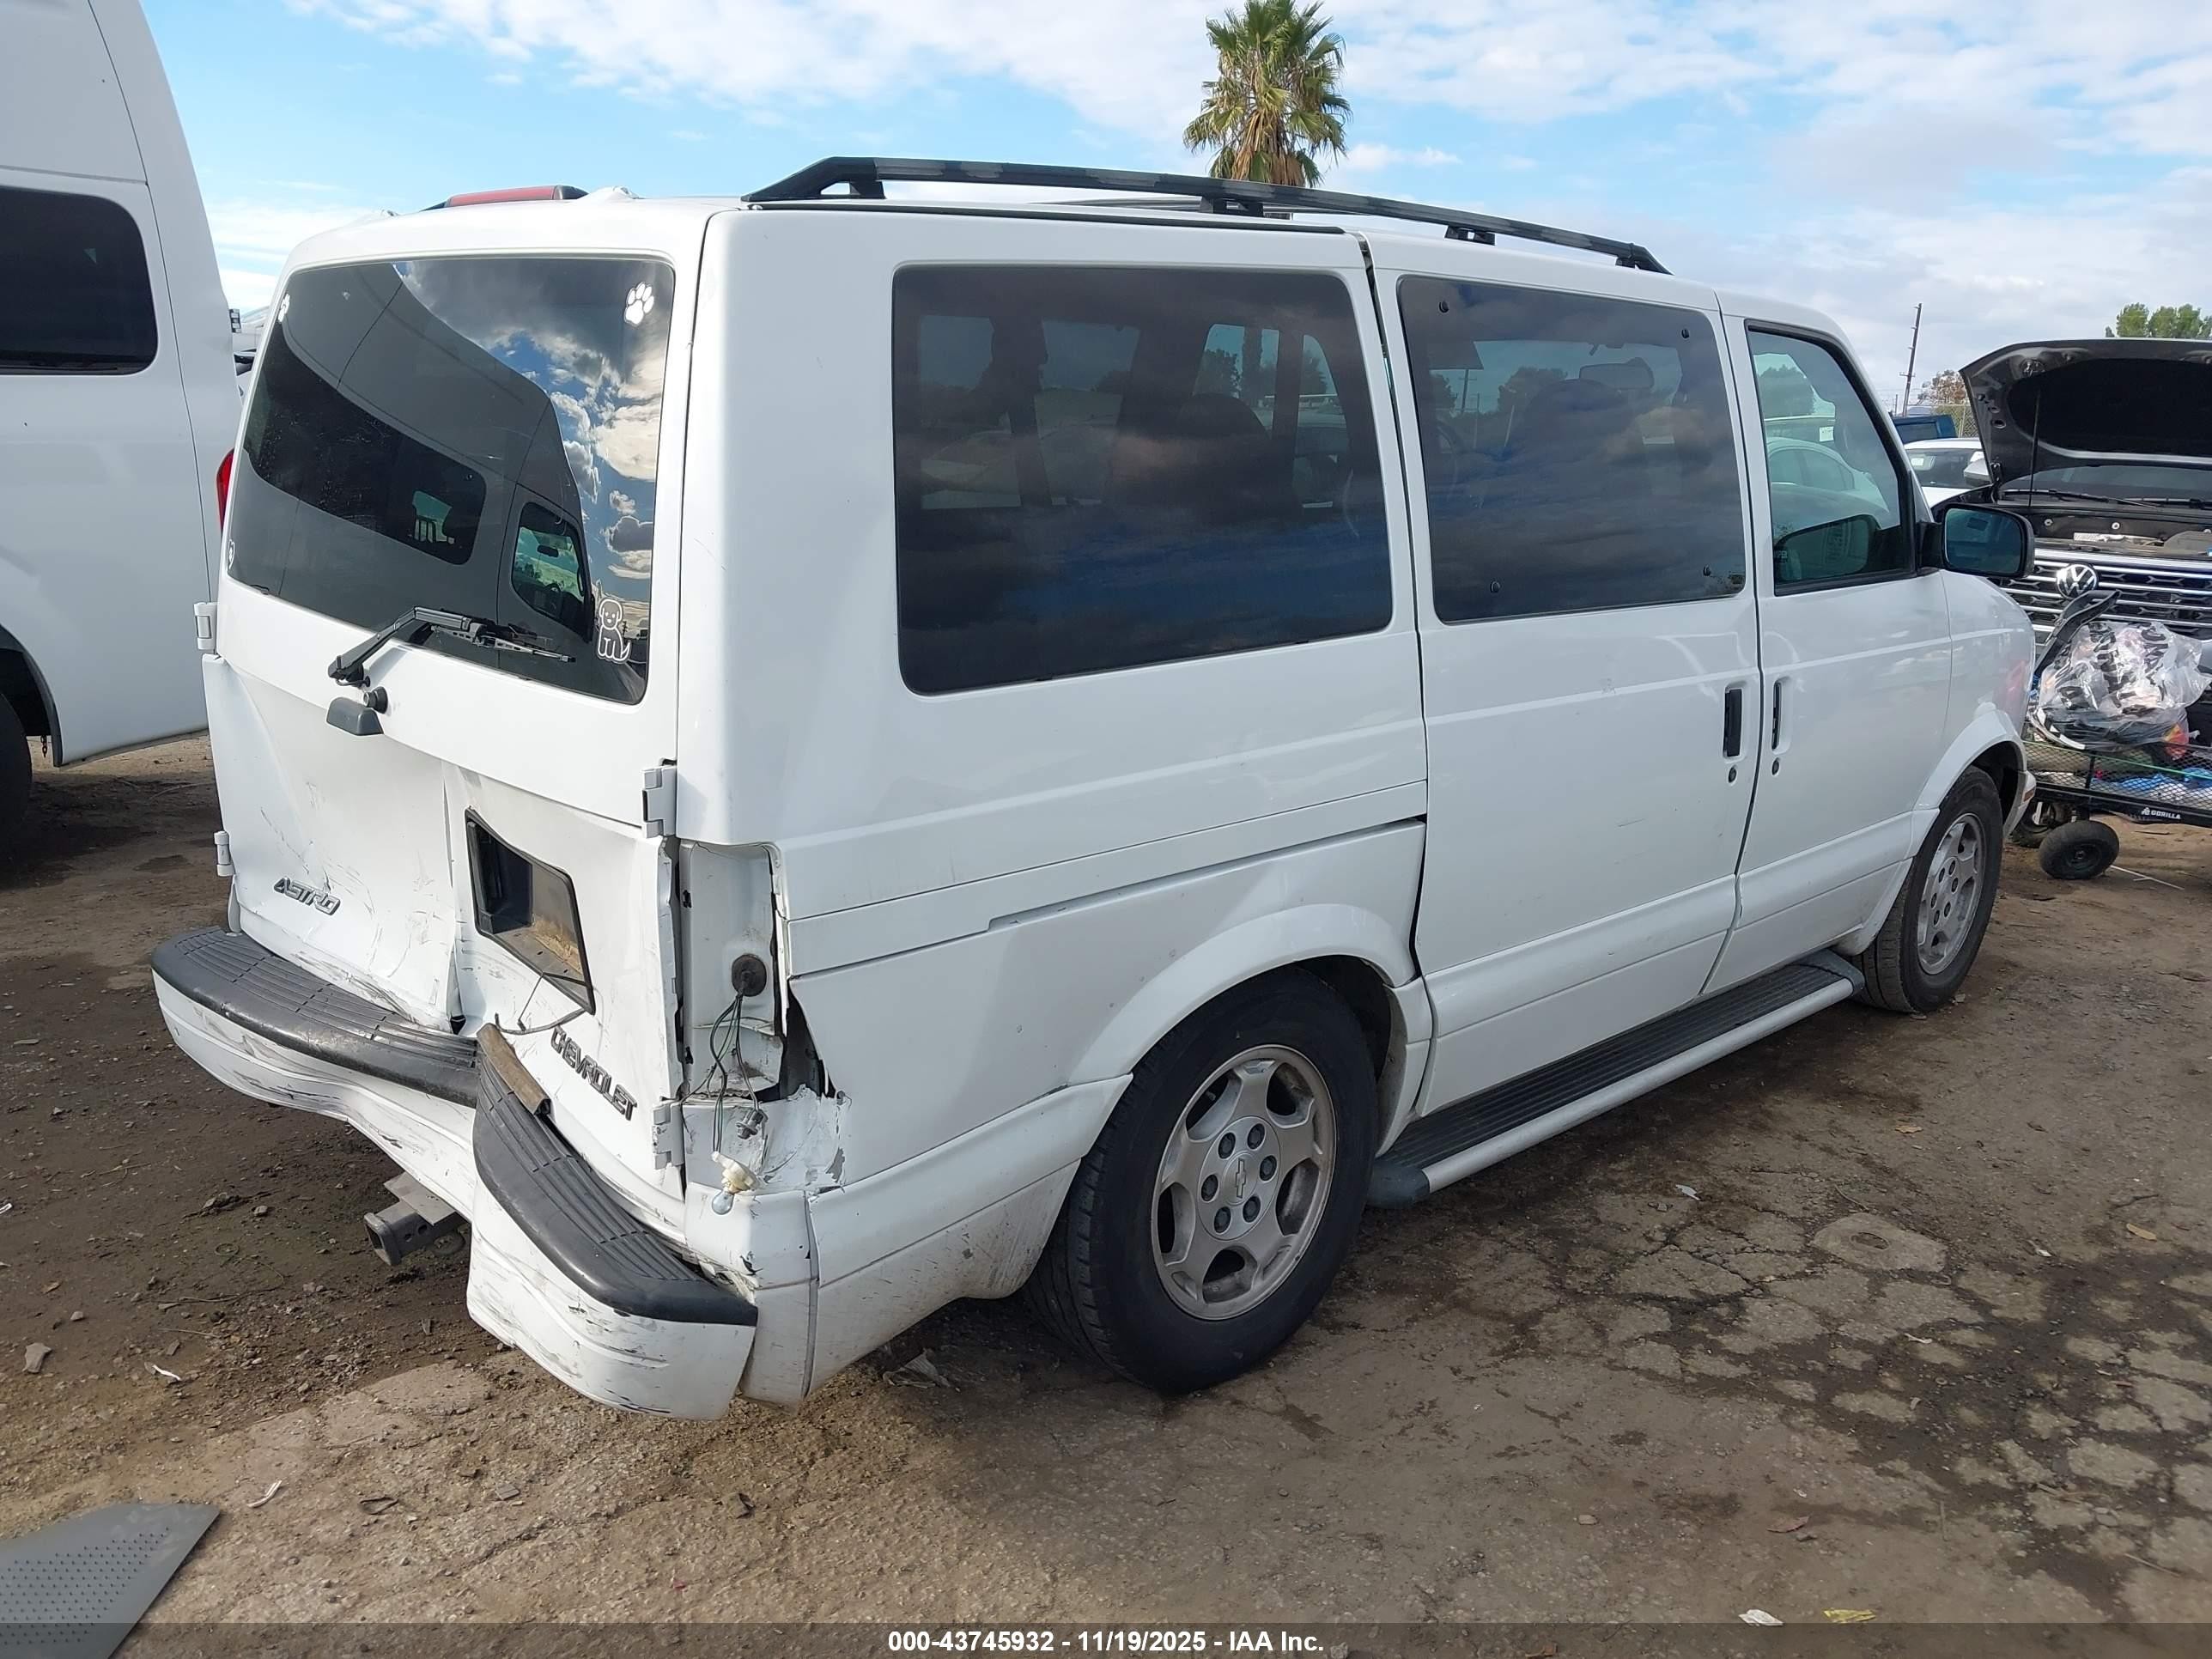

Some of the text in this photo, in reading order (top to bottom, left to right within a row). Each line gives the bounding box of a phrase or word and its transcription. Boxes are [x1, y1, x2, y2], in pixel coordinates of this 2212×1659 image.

[2151, 810, 2181, 819] GORILLA
[274, 877, 341, 915] ASTRO
[550, 1024, 637, 1121] CHEVROLET
